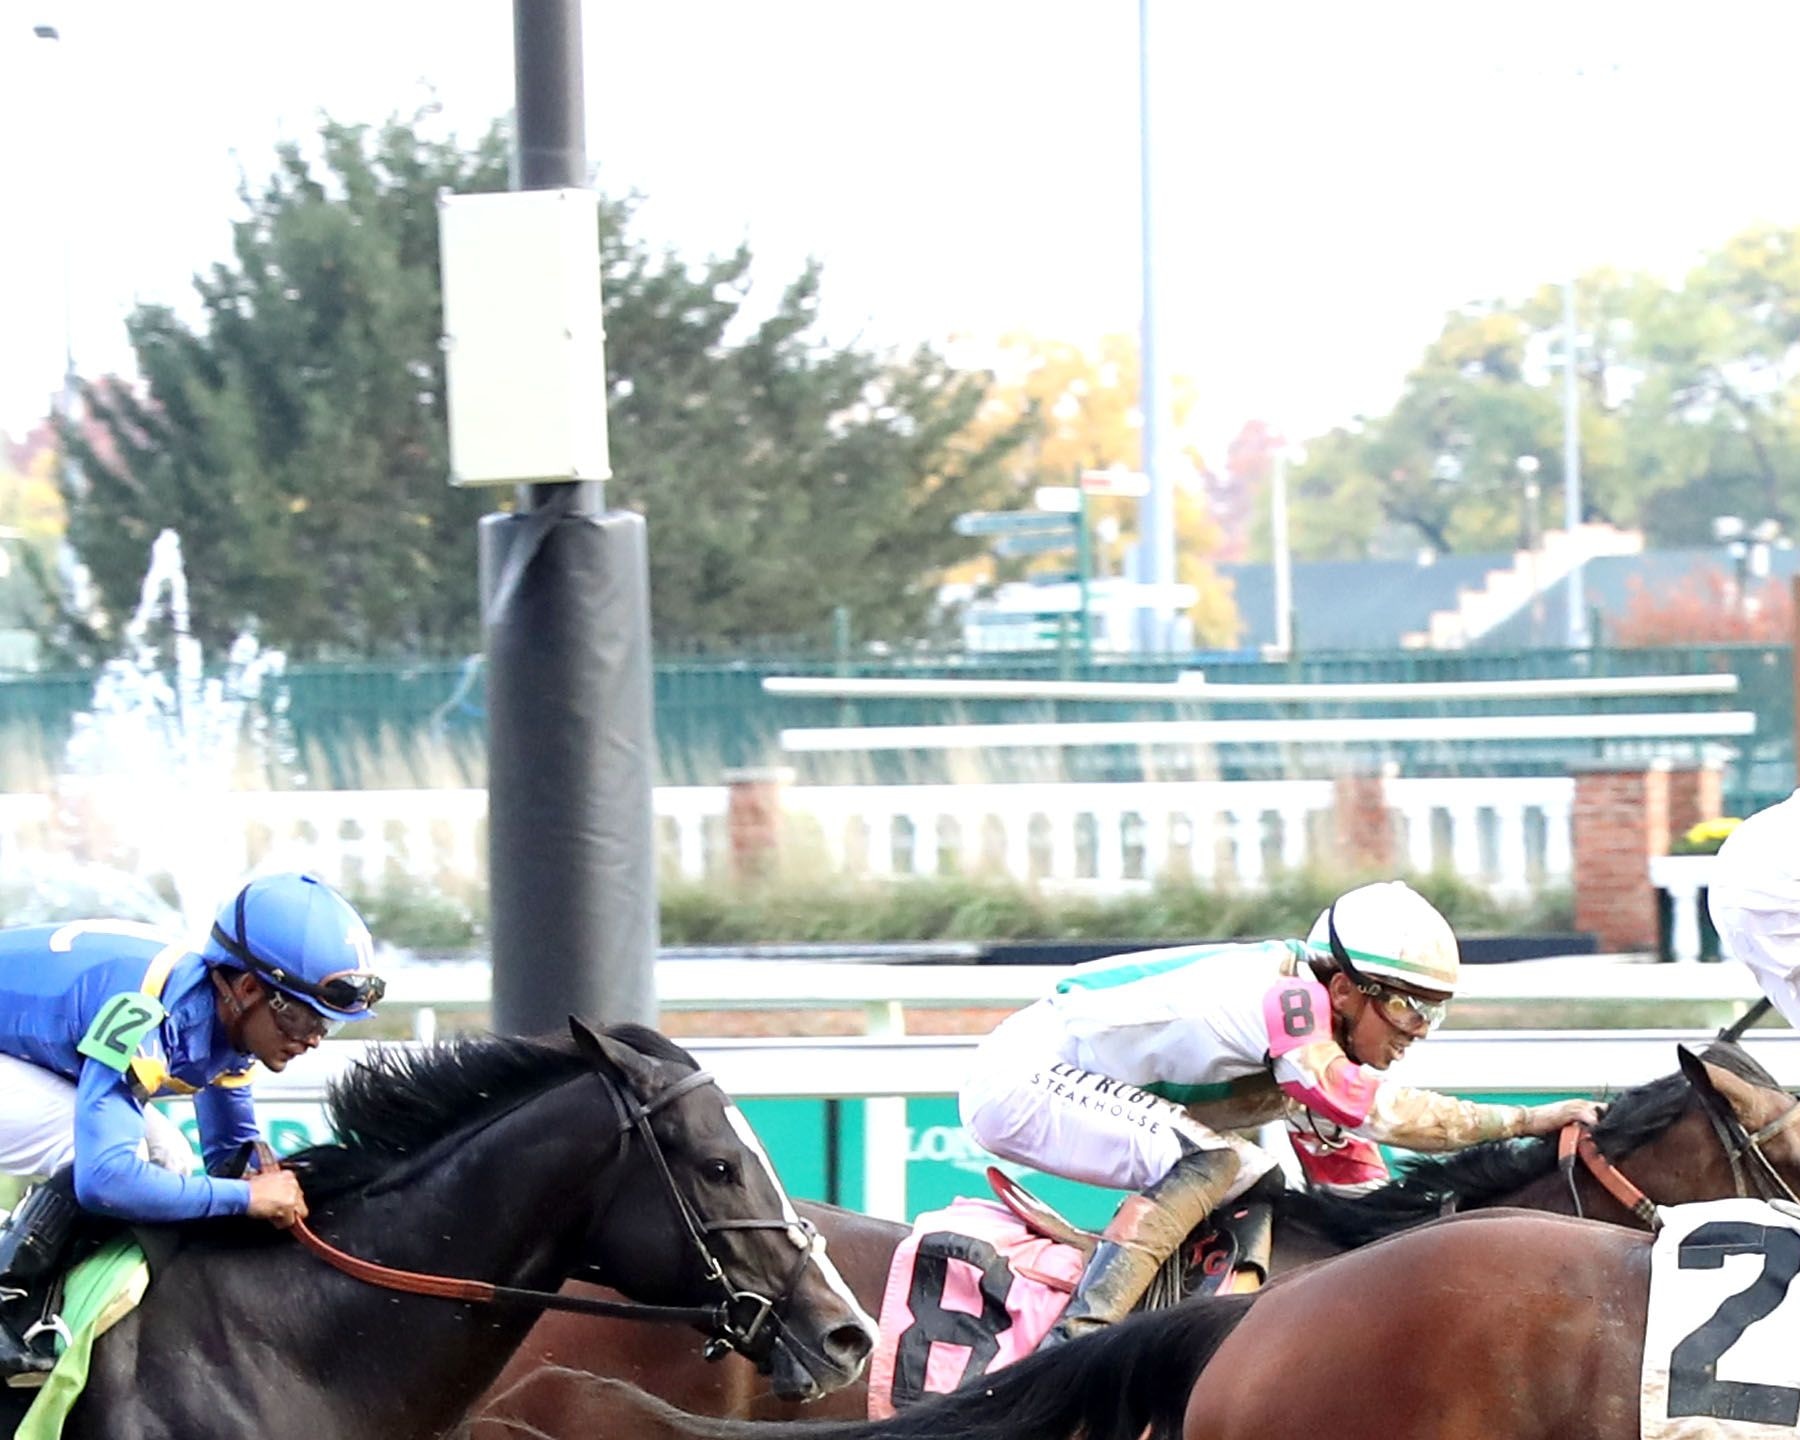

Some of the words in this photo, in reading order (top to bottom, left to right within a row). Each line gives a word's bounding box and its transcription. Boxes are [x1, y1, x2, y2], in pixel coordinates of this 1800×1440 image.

[93, 998, 152, 1055] 12
[1280, 988, 1316, 1038] 8
[1030, 1073, 1160, 1134] STEAKHOUSE
[891, 1231, 1015, 1406] 8
